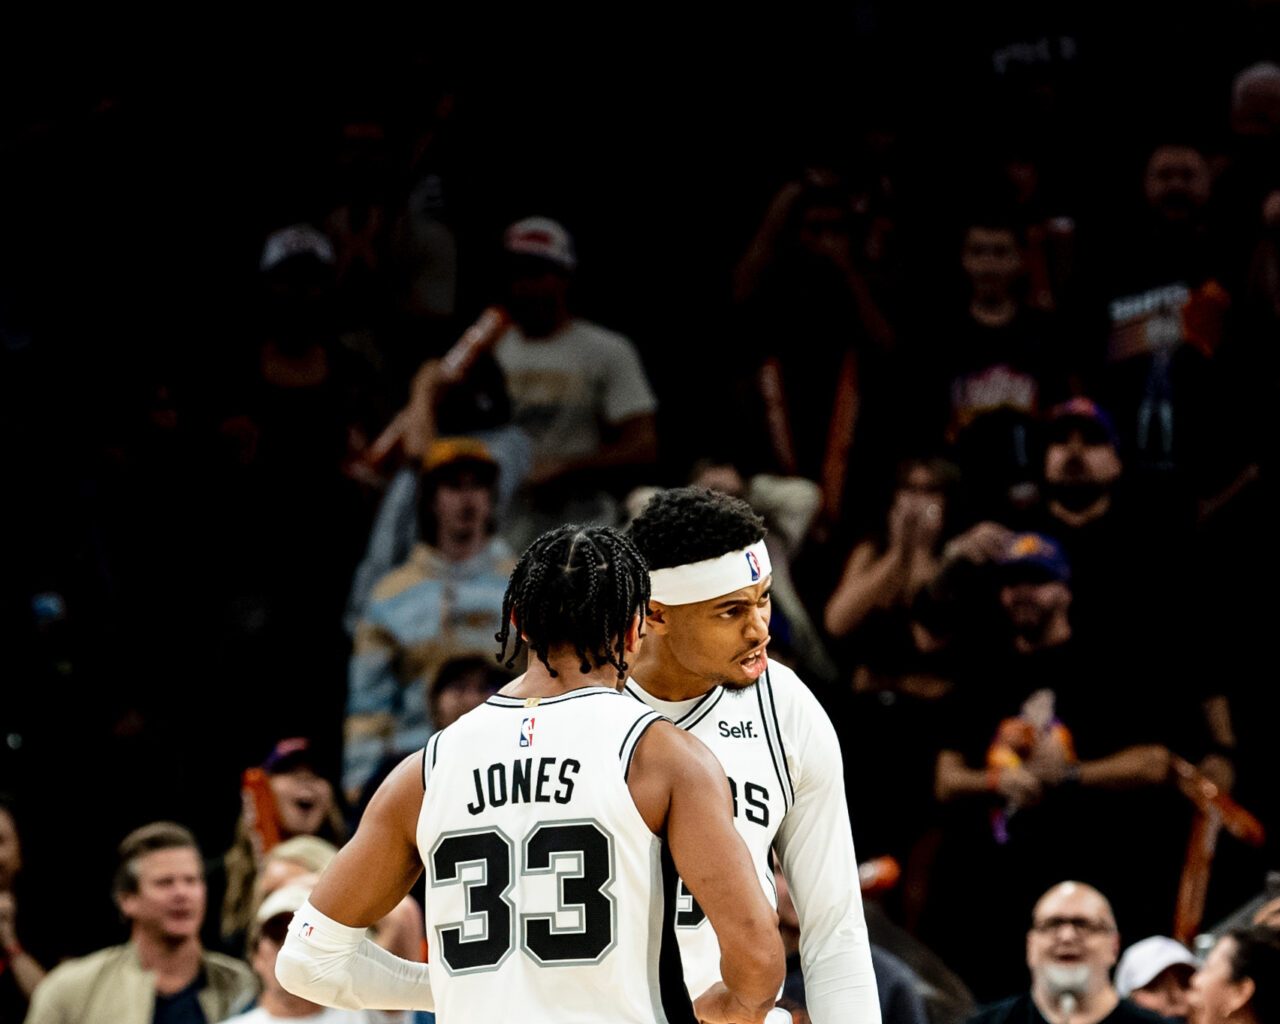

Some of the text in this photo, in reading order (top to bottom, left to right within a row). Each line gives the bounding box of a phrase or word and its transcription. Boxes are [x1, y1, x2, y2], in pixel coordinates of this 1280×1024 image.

[718, 720, 758, 738] Self.
[467, 757, 580, 816] JONES
[431, 819, 617, 976] 33
